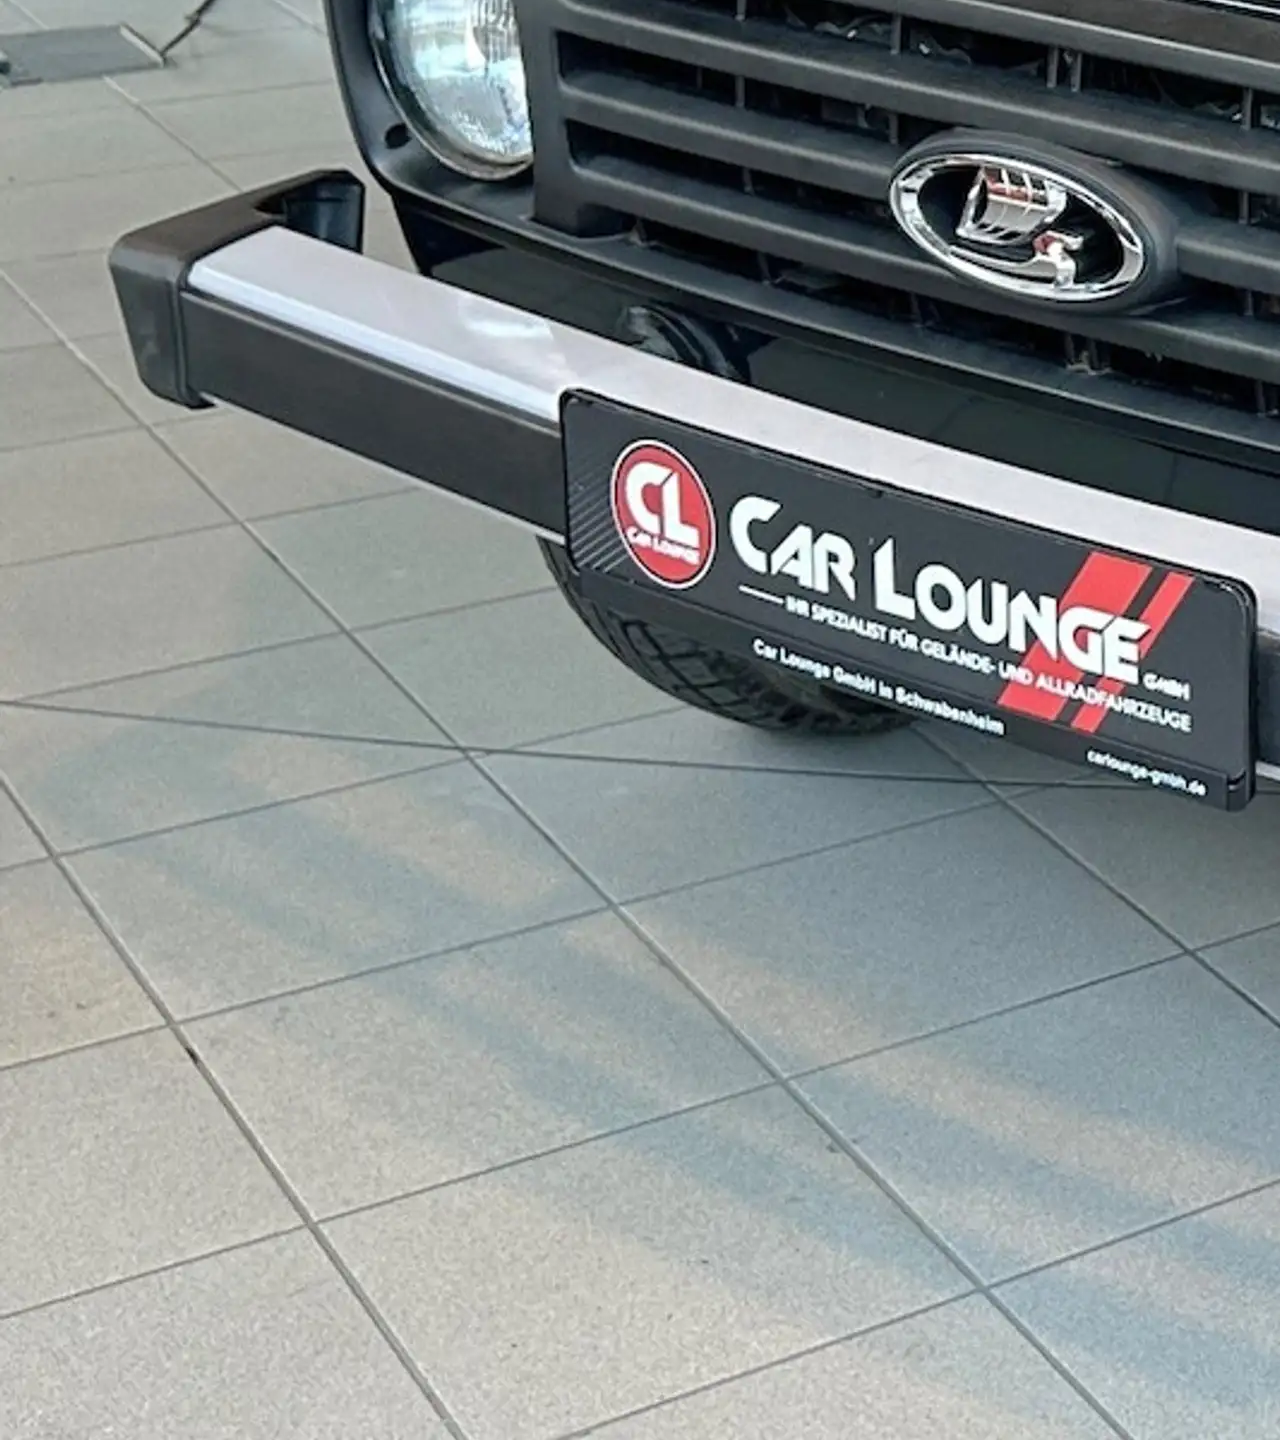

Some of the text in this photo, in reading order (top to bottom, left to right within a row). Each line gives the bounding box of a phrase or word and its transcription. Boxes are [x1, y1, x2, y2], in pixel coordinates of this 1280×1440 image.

[626, 461, 700, 548] CL
[729, 496, 857, 601] CAR
[874, 537, 1151, 685] LOUNGE
[753, 638, 1005, 736] Car Lounge GmbH in Schwabenheim
[811, 602, 888, 642] SPEZIALIST
[888, 628, 919, 652] FÜR
[919, 638, 996, 675] GELÄNDE-
[999, 661, 1033, 686] UND
[1035, 673, 1192, 733] ALLRADFAHRZEUGE
